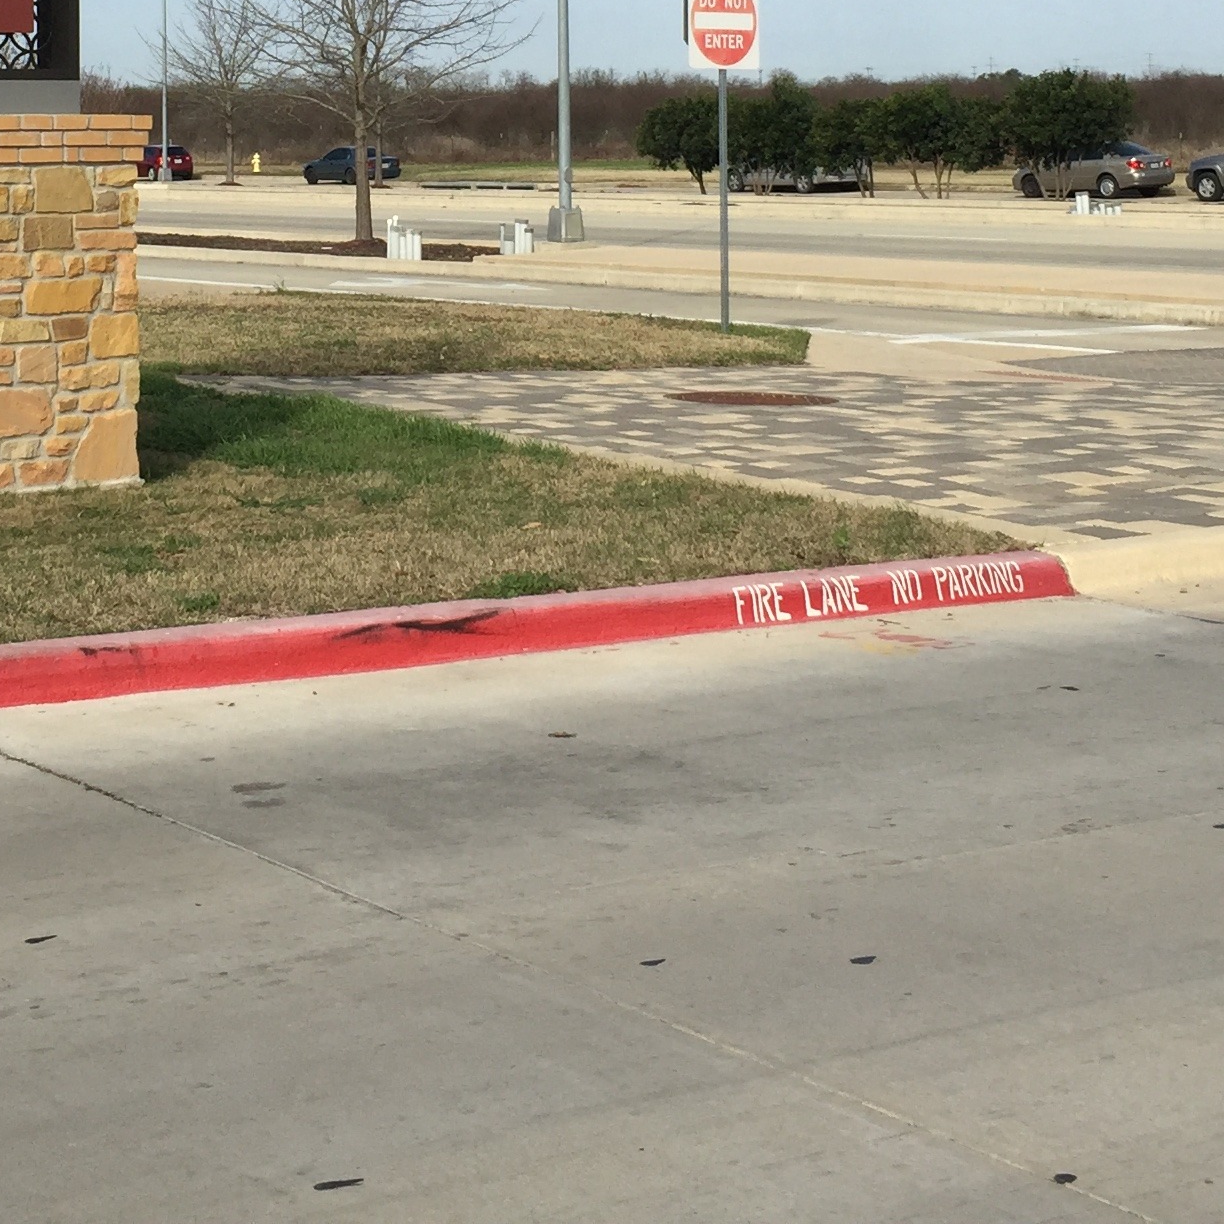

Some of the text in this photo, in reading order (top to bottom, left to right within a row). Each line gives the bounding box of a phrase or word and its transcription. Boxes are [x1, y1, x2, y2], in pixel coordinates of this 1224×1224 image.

[704, 34, 744, 49] ENTER
[732, 561, 1024, 625] FIRE LANE NO PARKING
